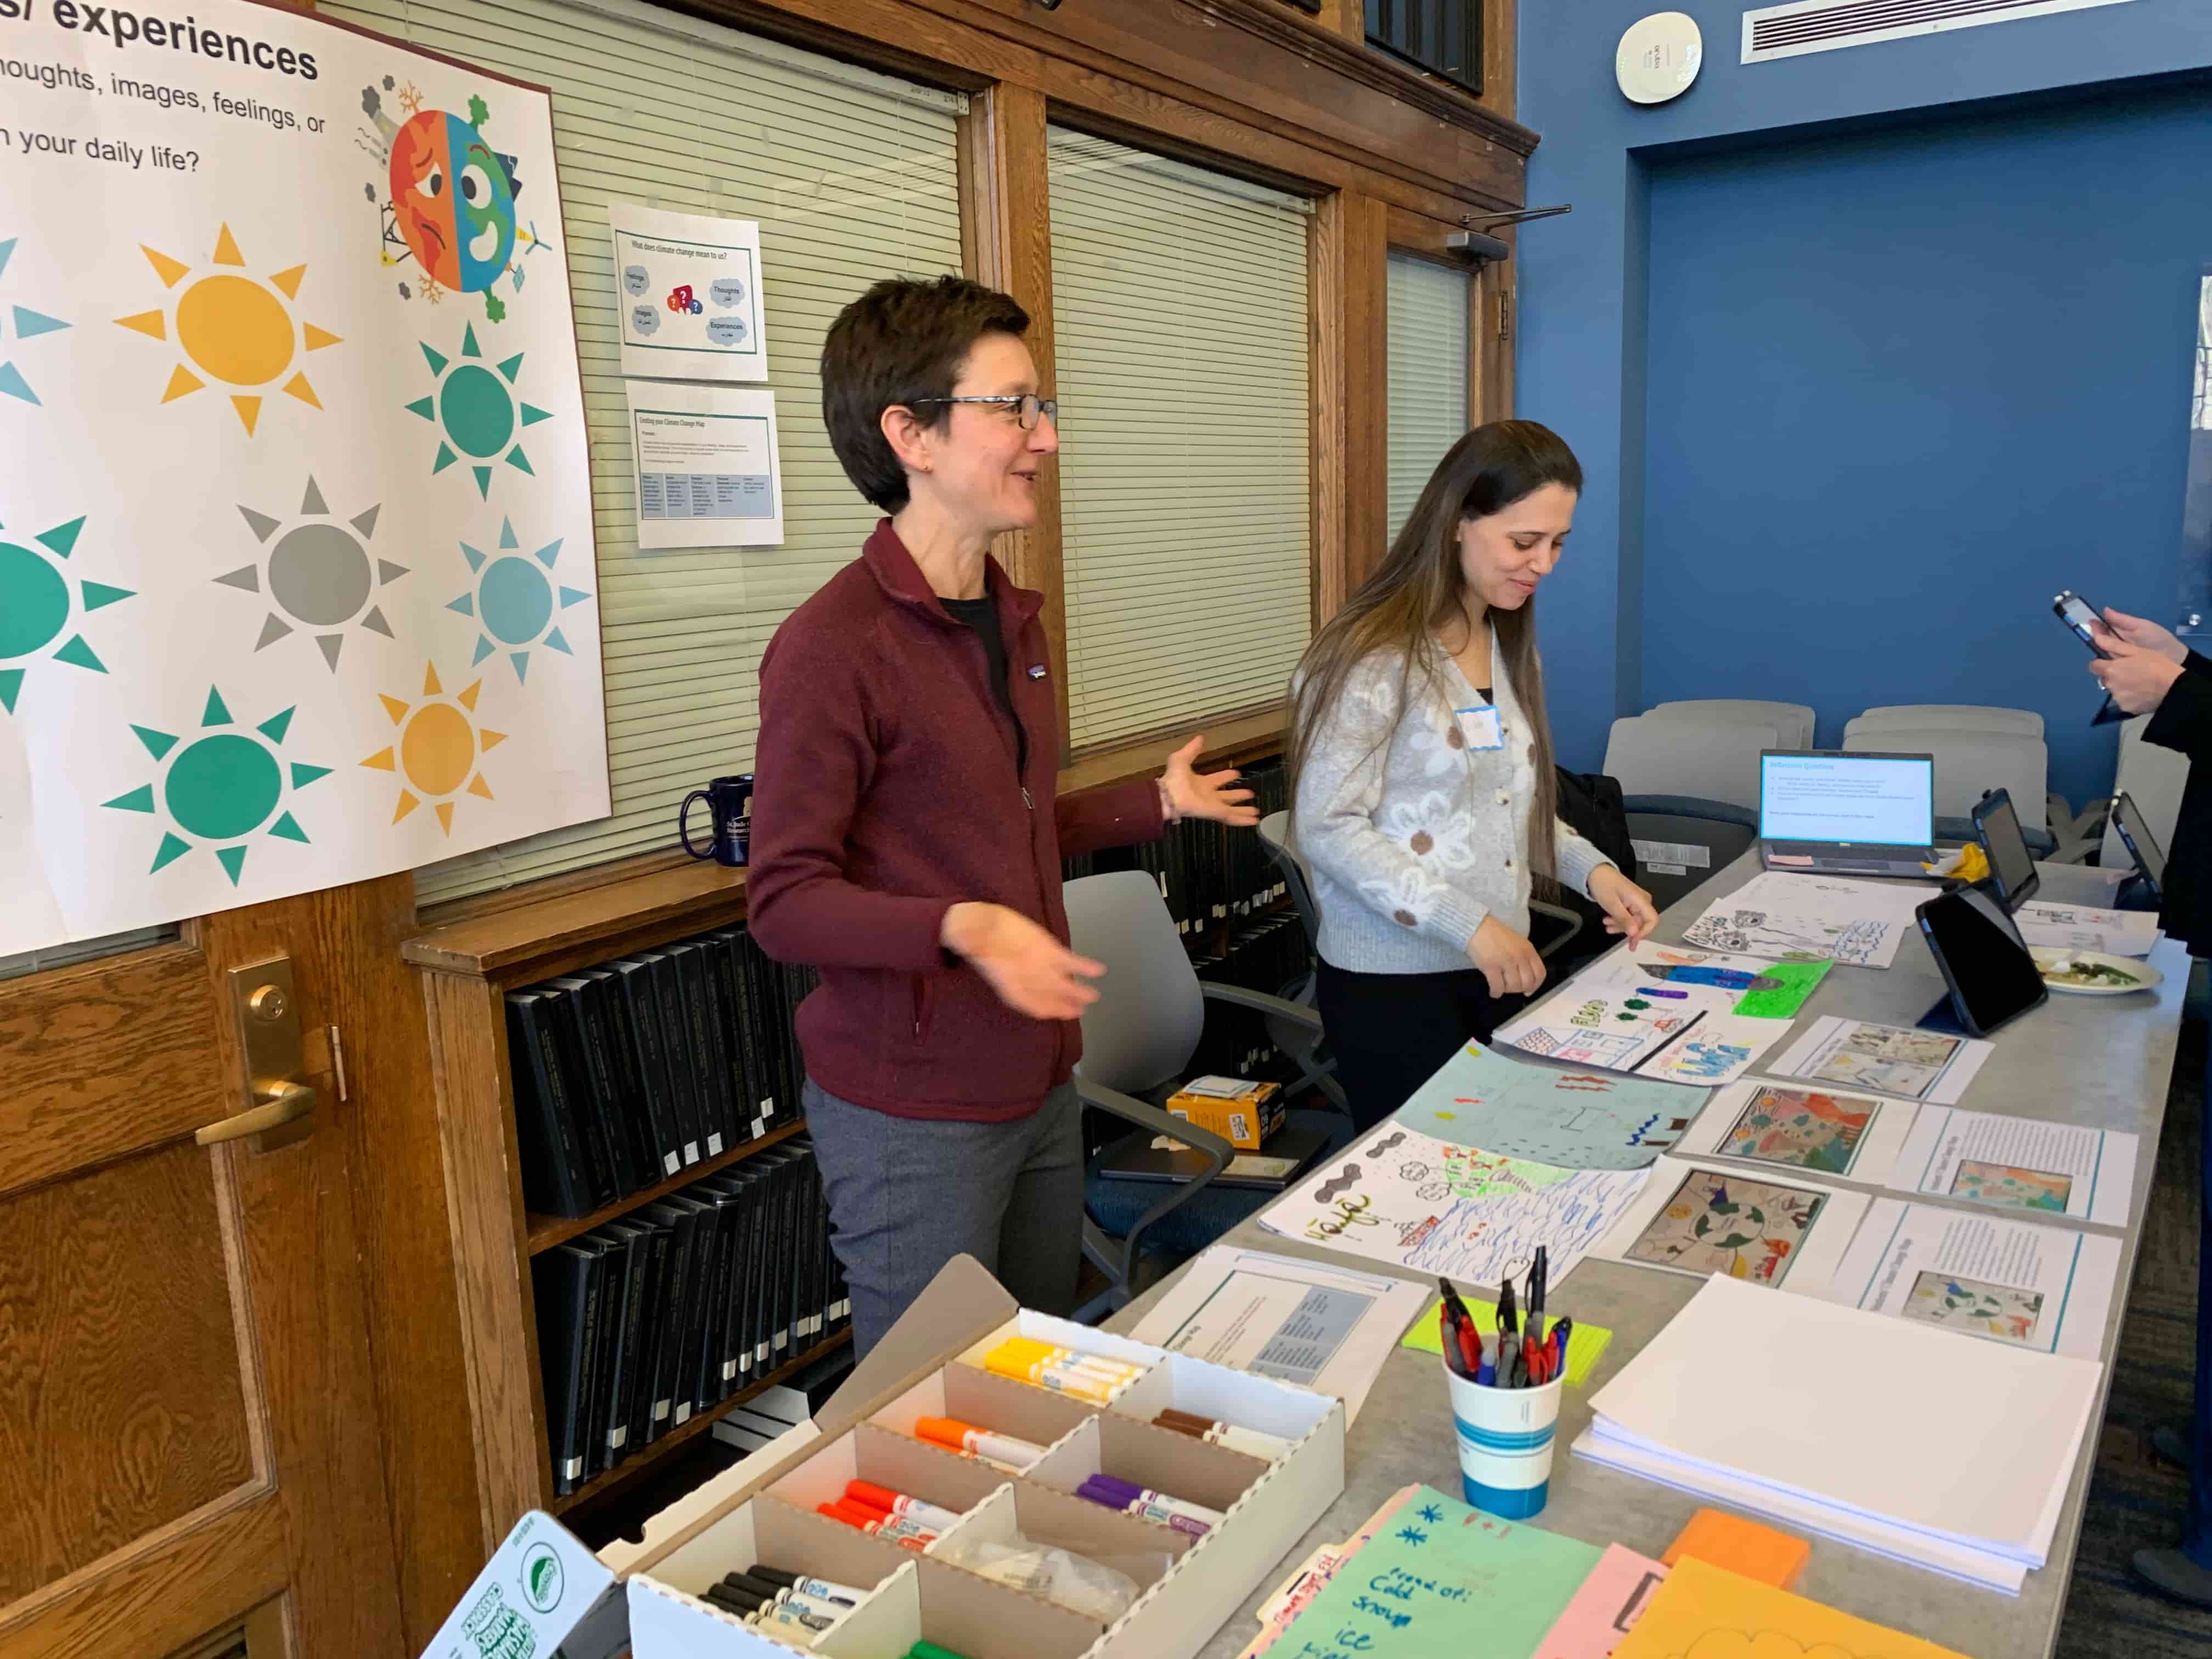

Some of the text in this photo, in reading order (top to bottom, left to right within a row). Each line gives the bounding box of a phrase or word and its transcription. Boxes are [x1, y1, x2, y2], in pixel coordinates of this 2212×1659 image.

[53, 0, 318, 80] experiences
[111, 72, 206, 113] images,
[213, 92, 301, 132] feelings,
[307, 115, 325, 133] or
[19, 131, 77, 154] your
[86, 137, 143, 169] daily
[151, 145, 199, 172] life?
[657, 245, 675, 254] climate
[676, 249, 694, 258] change
[714, 286, 740, 295] Thoughts
[710, 321, 743, 330] Experiences
